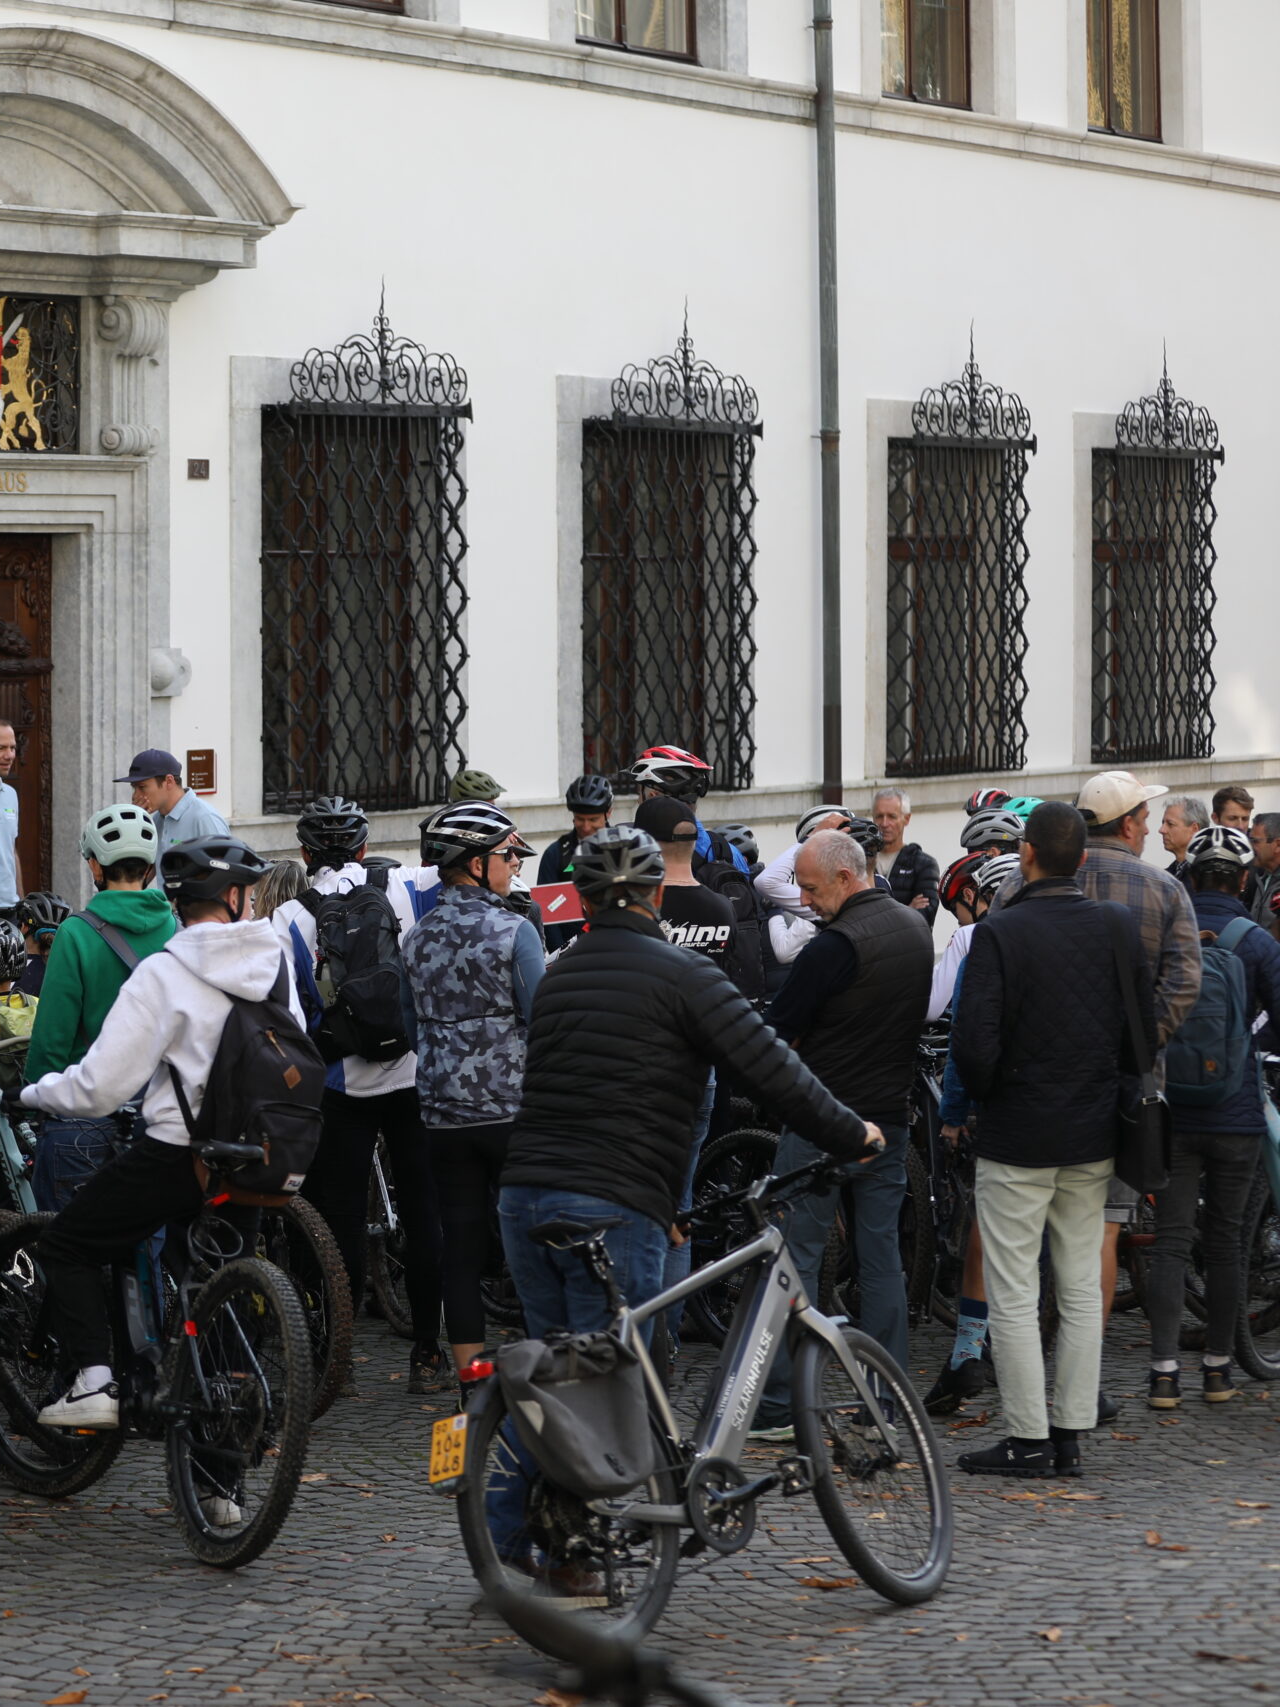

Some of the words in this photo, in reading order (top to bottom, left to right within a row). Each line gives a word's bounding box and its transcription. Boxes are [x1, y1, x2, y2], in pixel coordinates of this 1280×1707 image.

[193, 461, 206, 477] 24
[668, 924, 730, 946] nino
[436, 1433, 461, 1455] 104
[432, 1455, 460, 1476] 448
